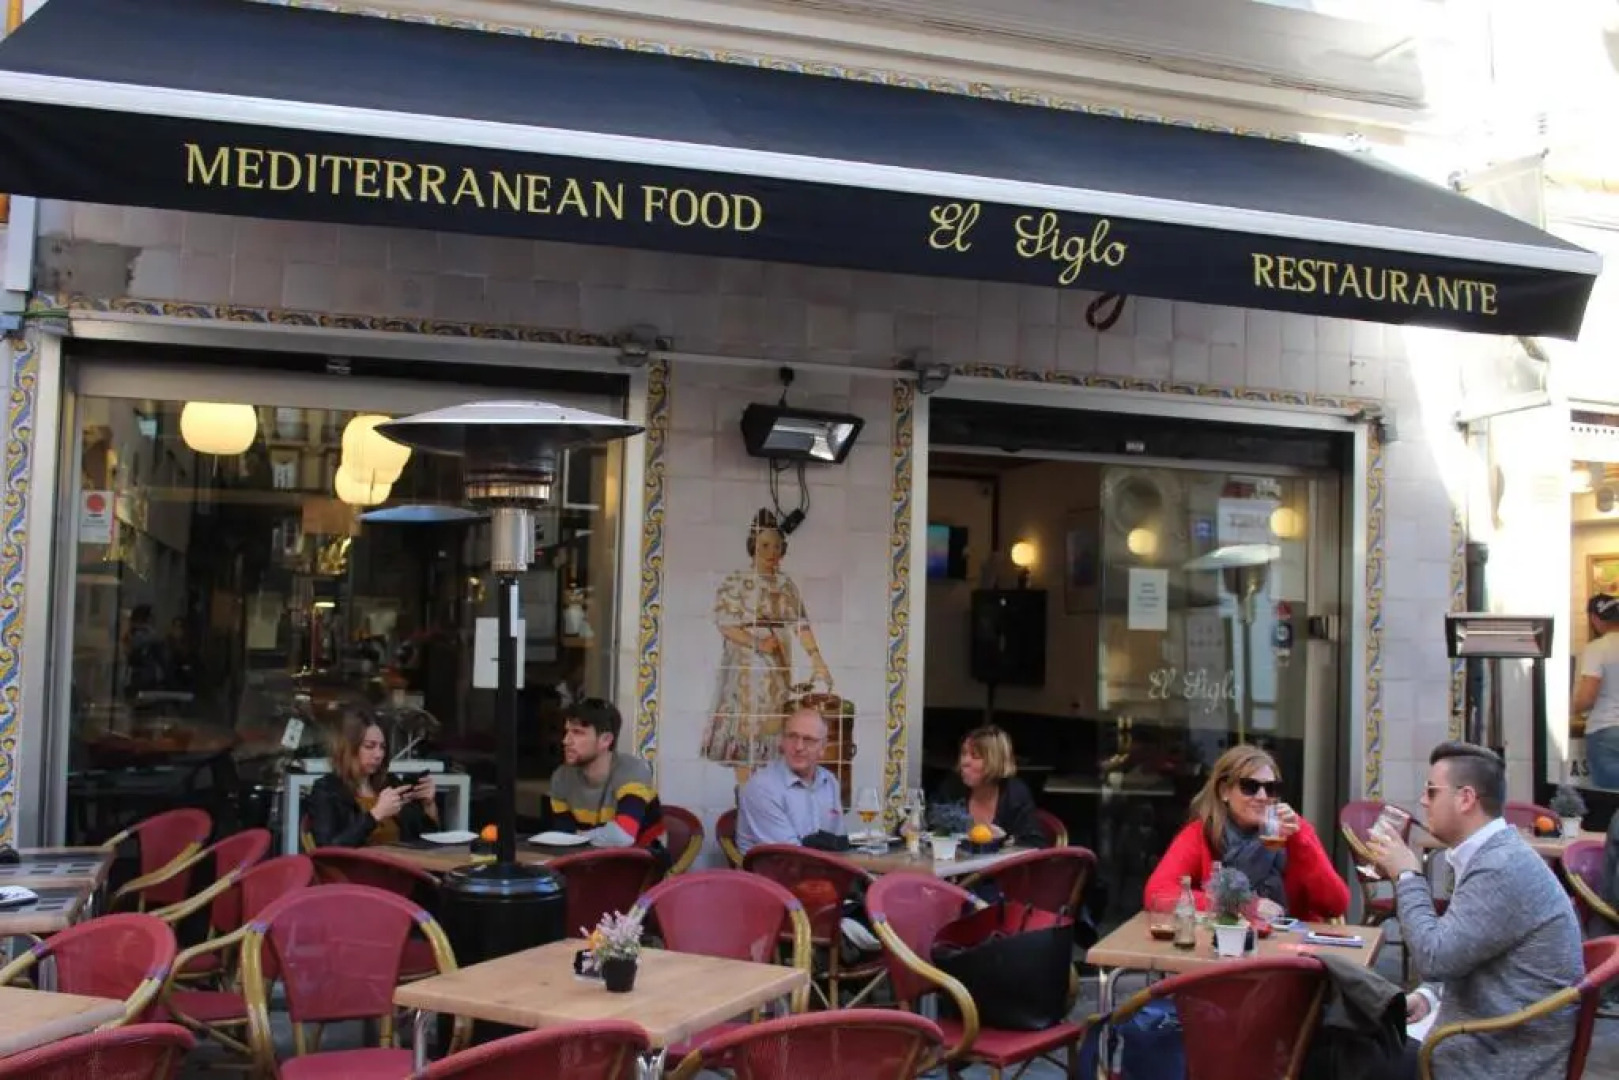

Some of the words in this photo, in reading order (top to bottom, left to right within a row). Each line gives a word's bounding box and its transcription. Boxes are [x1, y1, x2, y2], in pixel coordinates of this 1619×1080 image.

[185, 142, 625, 221] MEDITERRANEAN
[643, 185, 764, 233] FOOD
[928, 202, 980, 253] El
[1015, 211, 1128, 285] Siglo
[1252, 252, 1498, 316] RESTAURANTE
